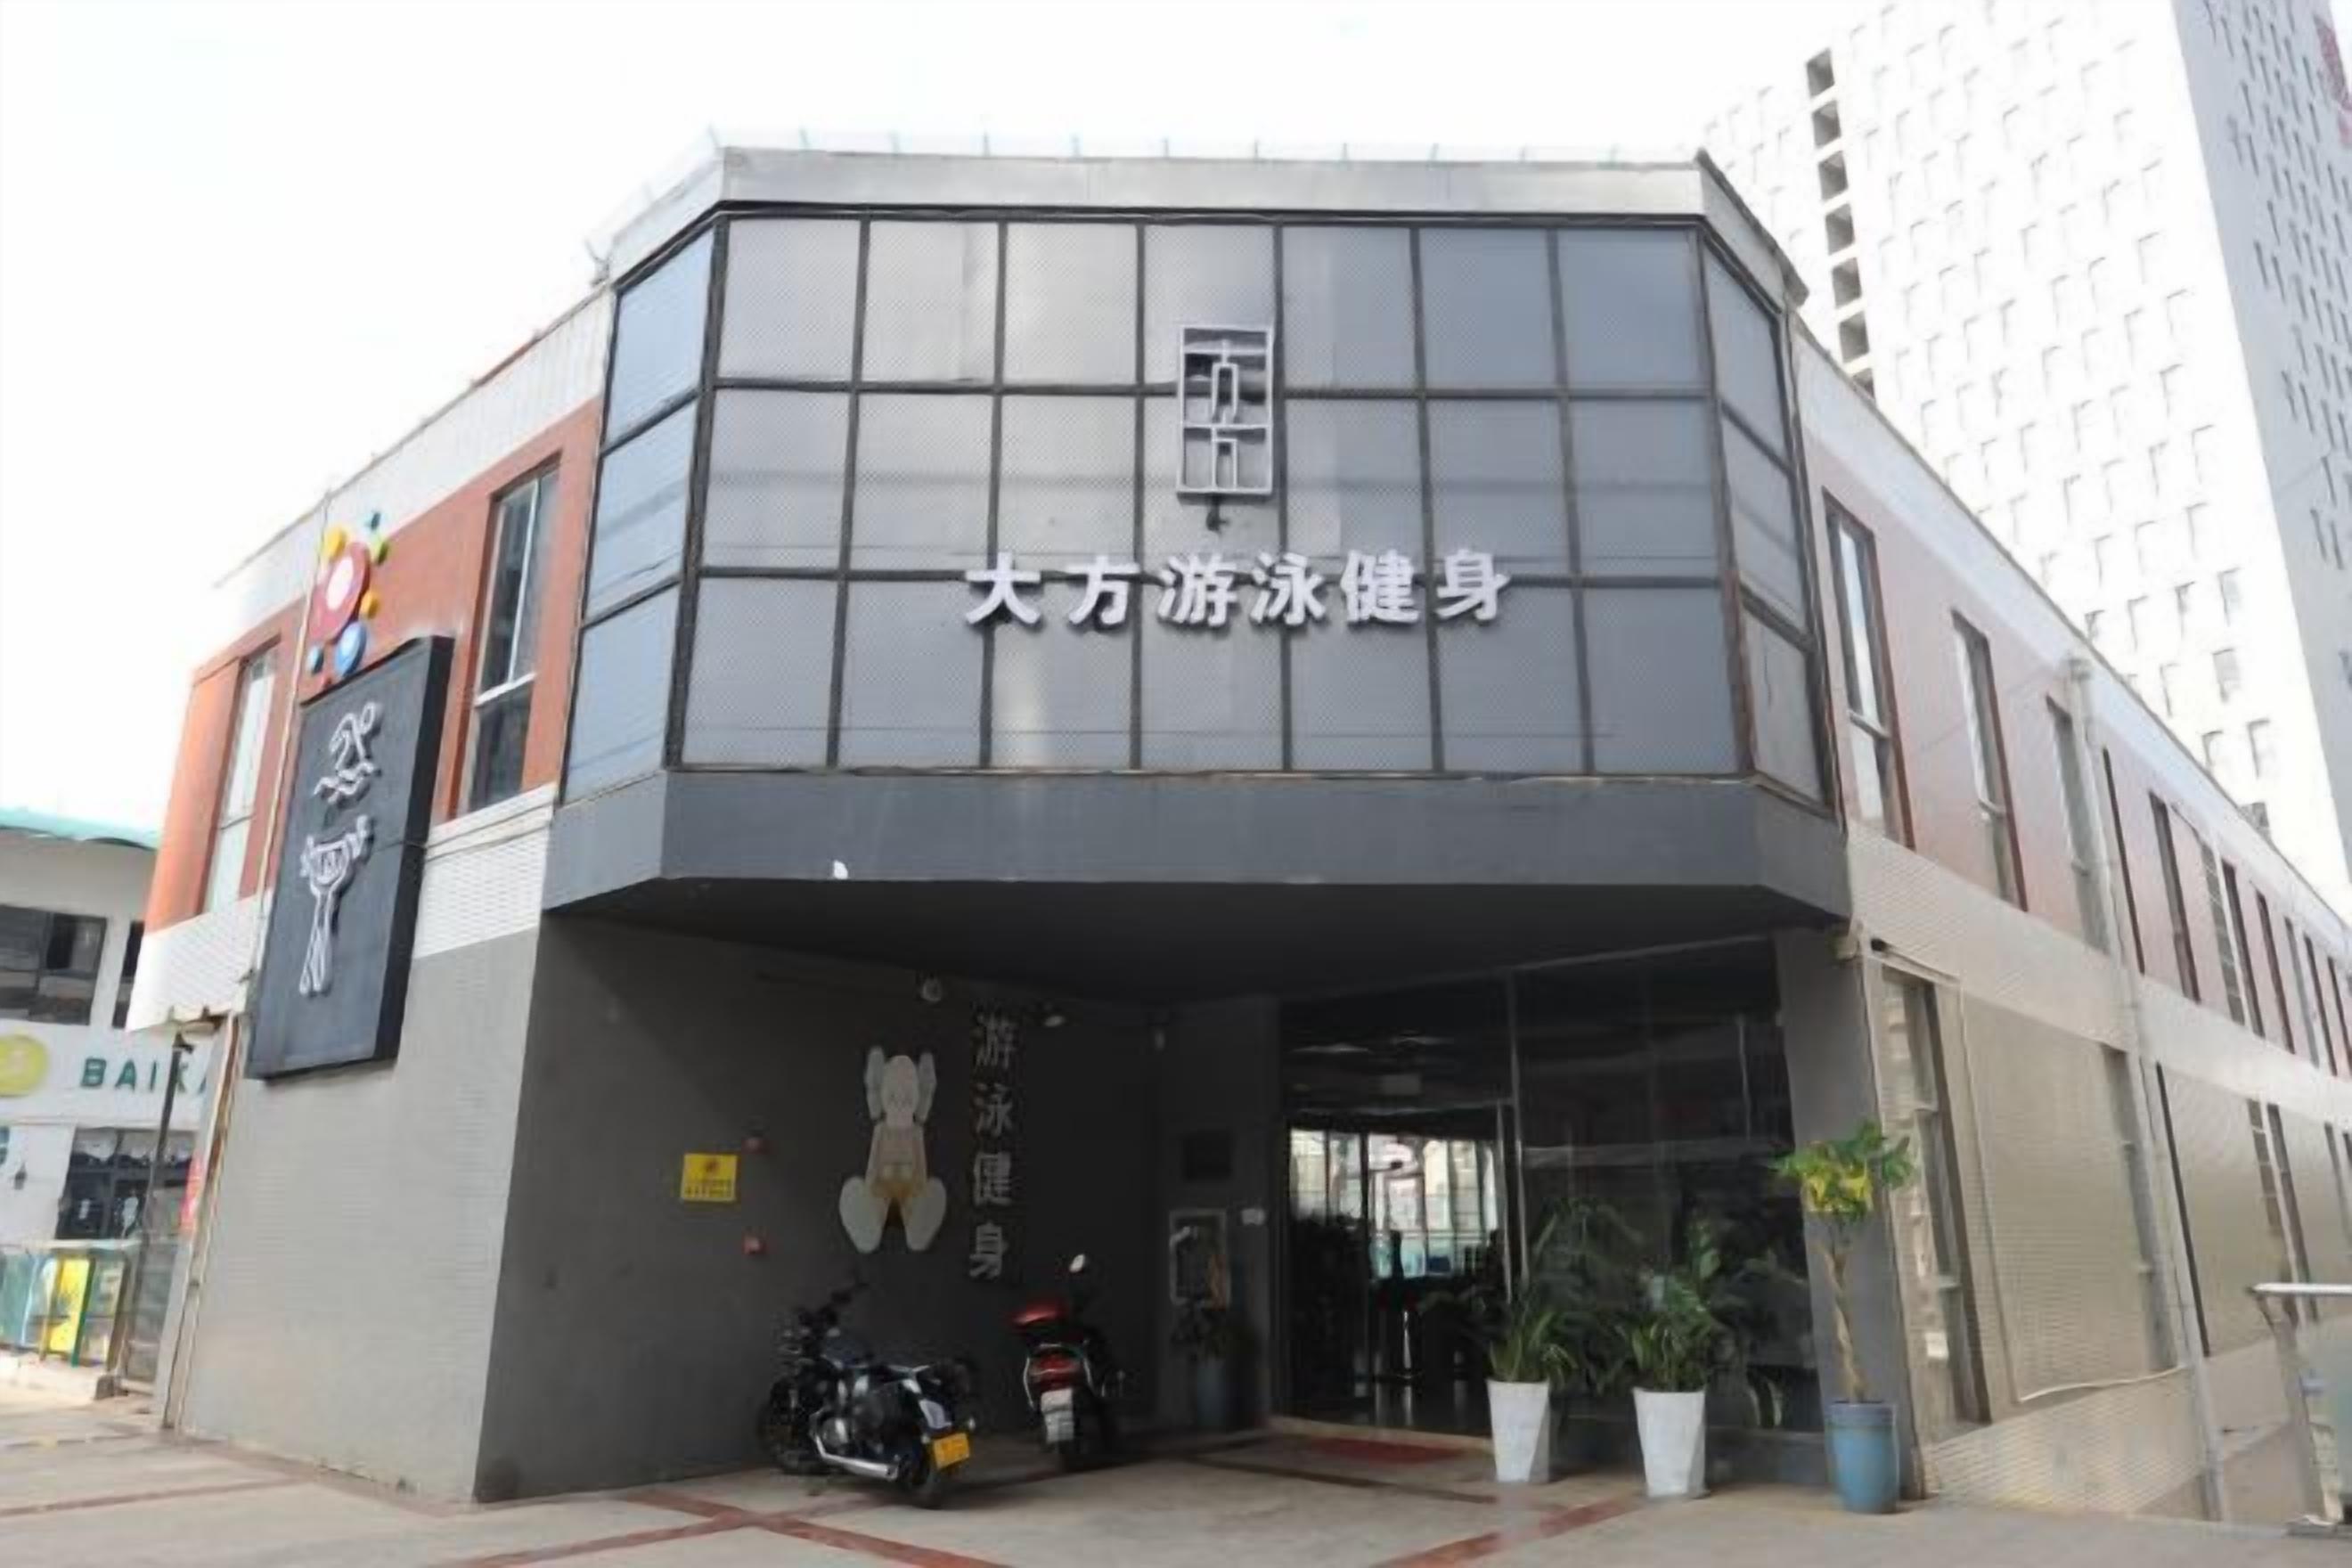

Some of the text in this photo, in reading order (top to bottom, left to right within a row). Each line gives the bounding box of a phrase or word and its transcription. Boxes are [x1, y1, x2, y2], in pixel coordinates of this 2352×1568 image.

[965, 549, 1510, 625] 大方游泳健身
[81, 1058, 207, 1095] BAIK
[970, 1012, 1016, 1280] 游泳健身
